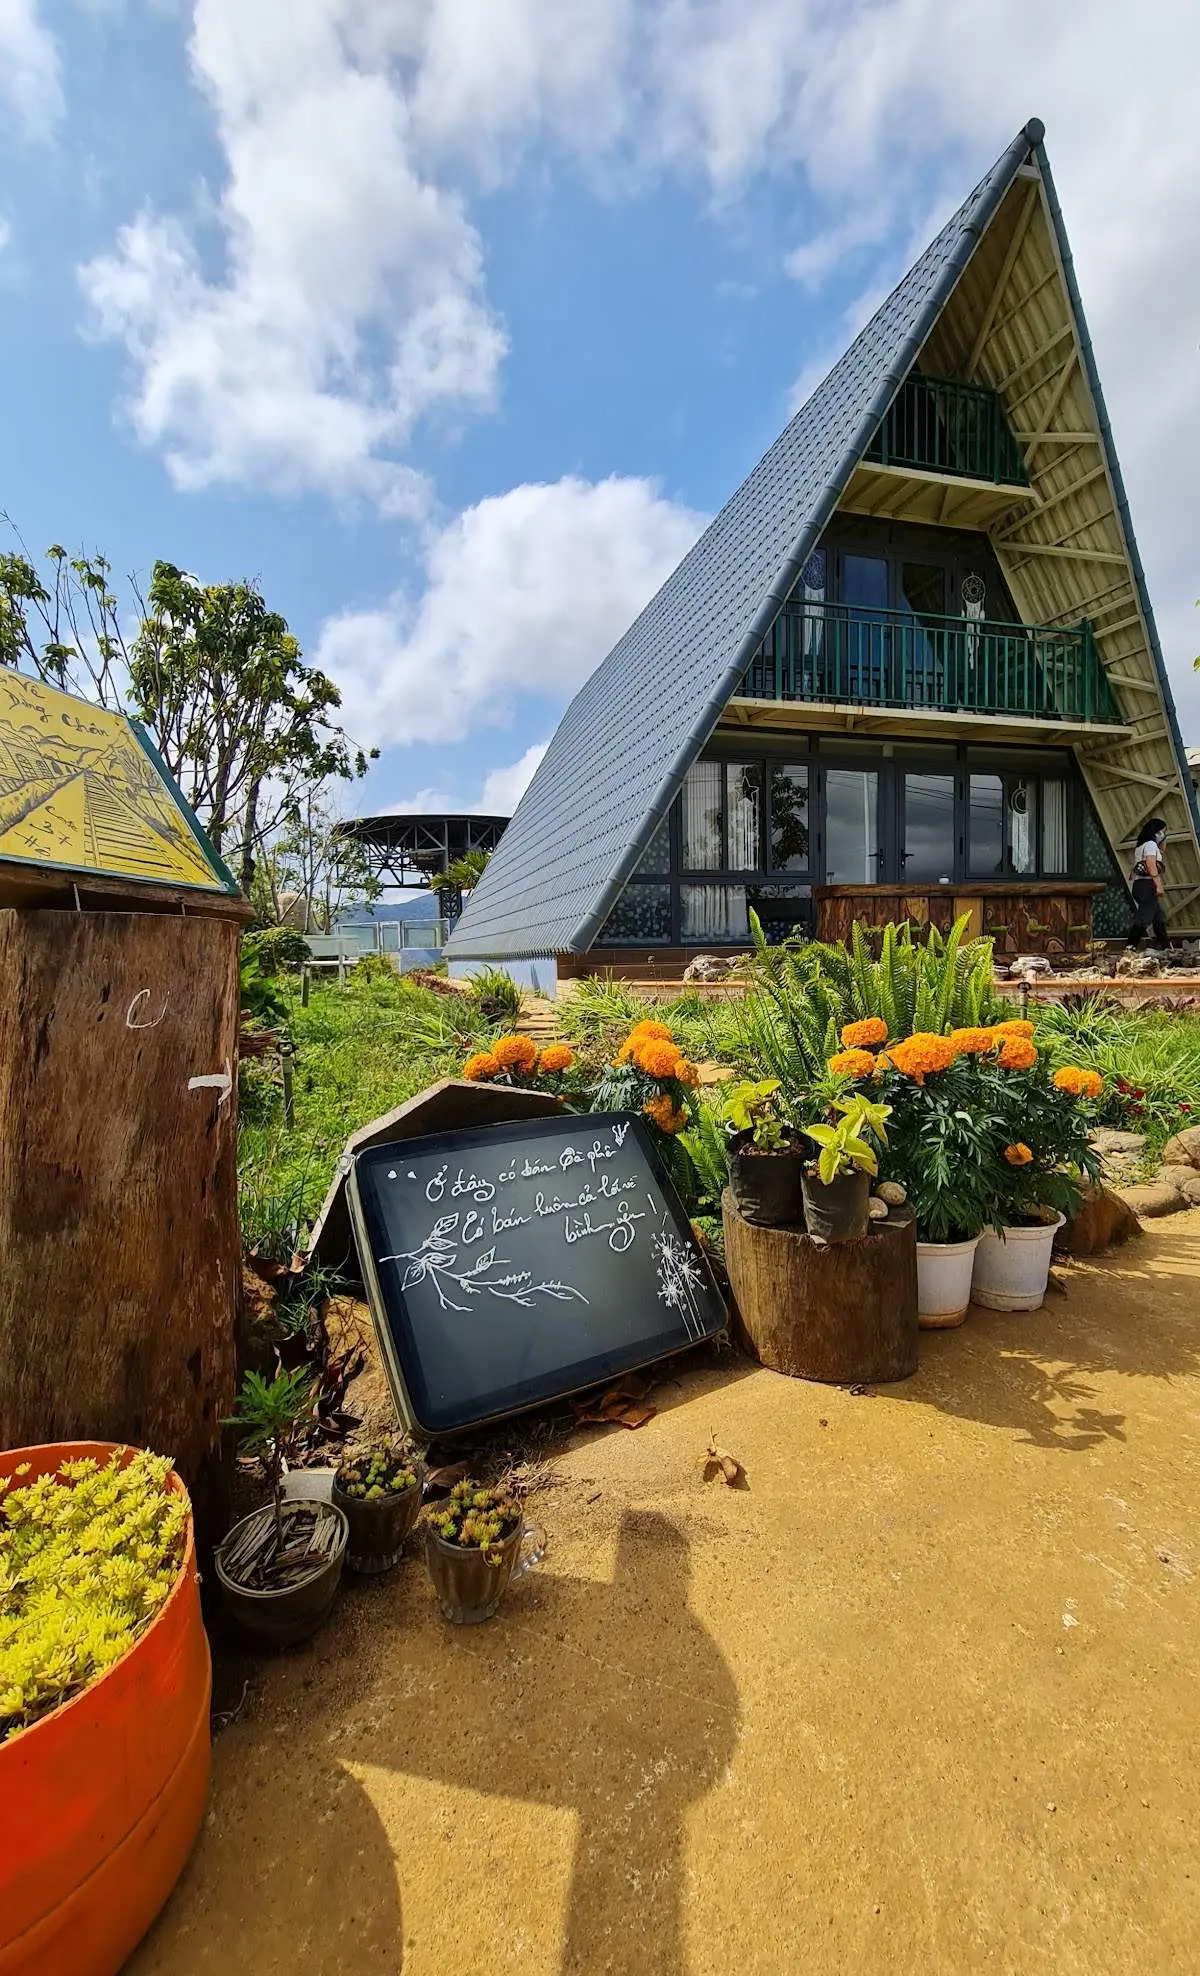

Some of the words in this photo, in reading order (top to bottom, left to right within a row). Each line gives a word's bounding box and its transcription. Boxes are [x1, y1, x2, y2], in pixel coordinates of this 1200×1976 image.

[61, 713, 110, 738] Chân
[425, 1164, 449, 1202] Ở
[451, 1168, 496, 1202] đây
[499, 1159, 516, 1182] có
[521, 1159, 557, 1177] bán
[587, 1140, 617, 1173] phê
[491, 1206, 532, 1235] bán
[565, 1212, 615, 1243] bình
